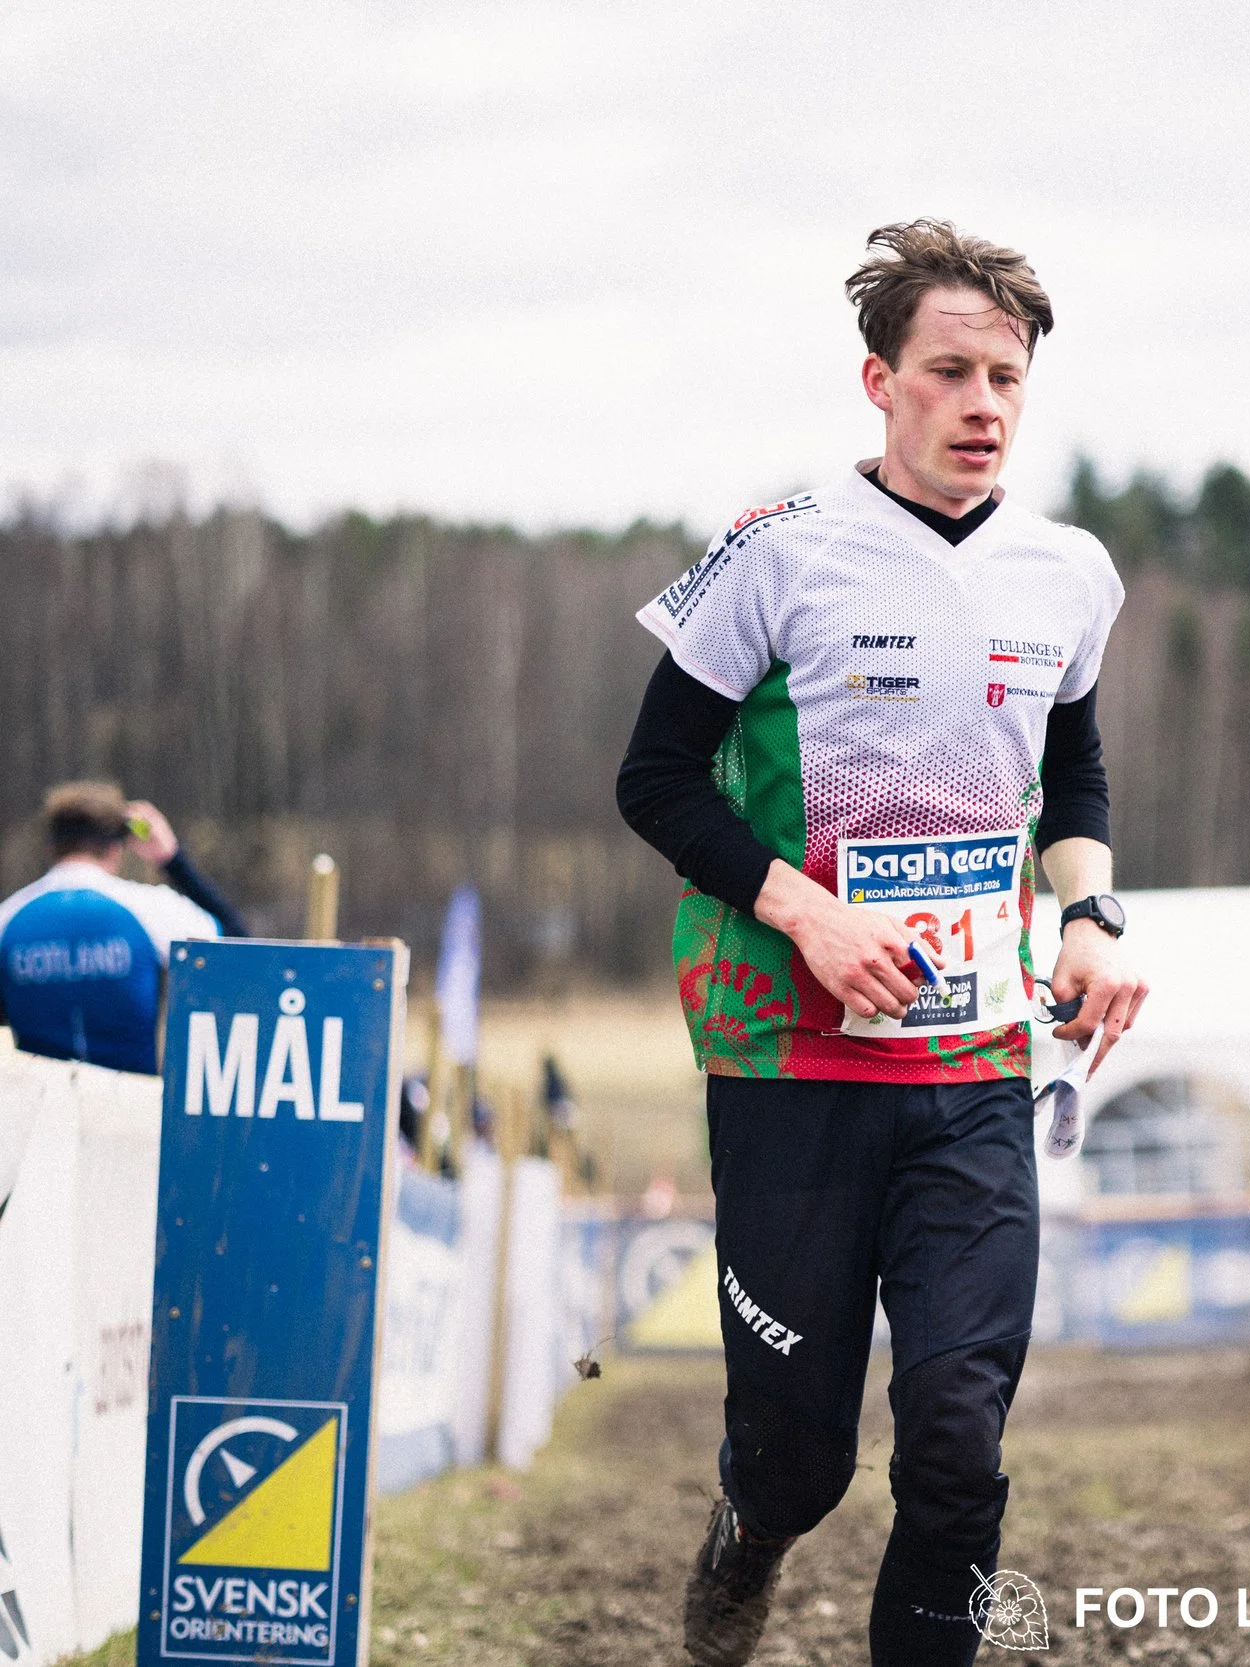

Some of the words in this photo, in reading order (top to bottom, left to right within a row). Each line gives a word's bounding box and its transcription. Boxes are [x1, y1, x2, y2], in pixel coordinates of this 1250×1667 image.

[678, 554, 732, 628] MOUNTAIN
[736, 521, 772, 549] BIKE
[852, 635, 917, 649] TRIMTEX
[989, 639, 1050, 656] TULLINGE
[1052, 645, 1064, 658] SK
[866, 676, 920, 689] TIGER
[848, 844, 1017, 882] bagheera
[865, 884, 958, 899] KOLMÅRDSKAVLEN
[983, 879, 1001, 891] 2026
[184, 987, 365, 1122] MÅL
[724, 1265, 804, 1356] TRIMTEX
[172, 1575, 329, 1619] SVENSK
[170, 1616, 329, 1648] ORIENTERING
